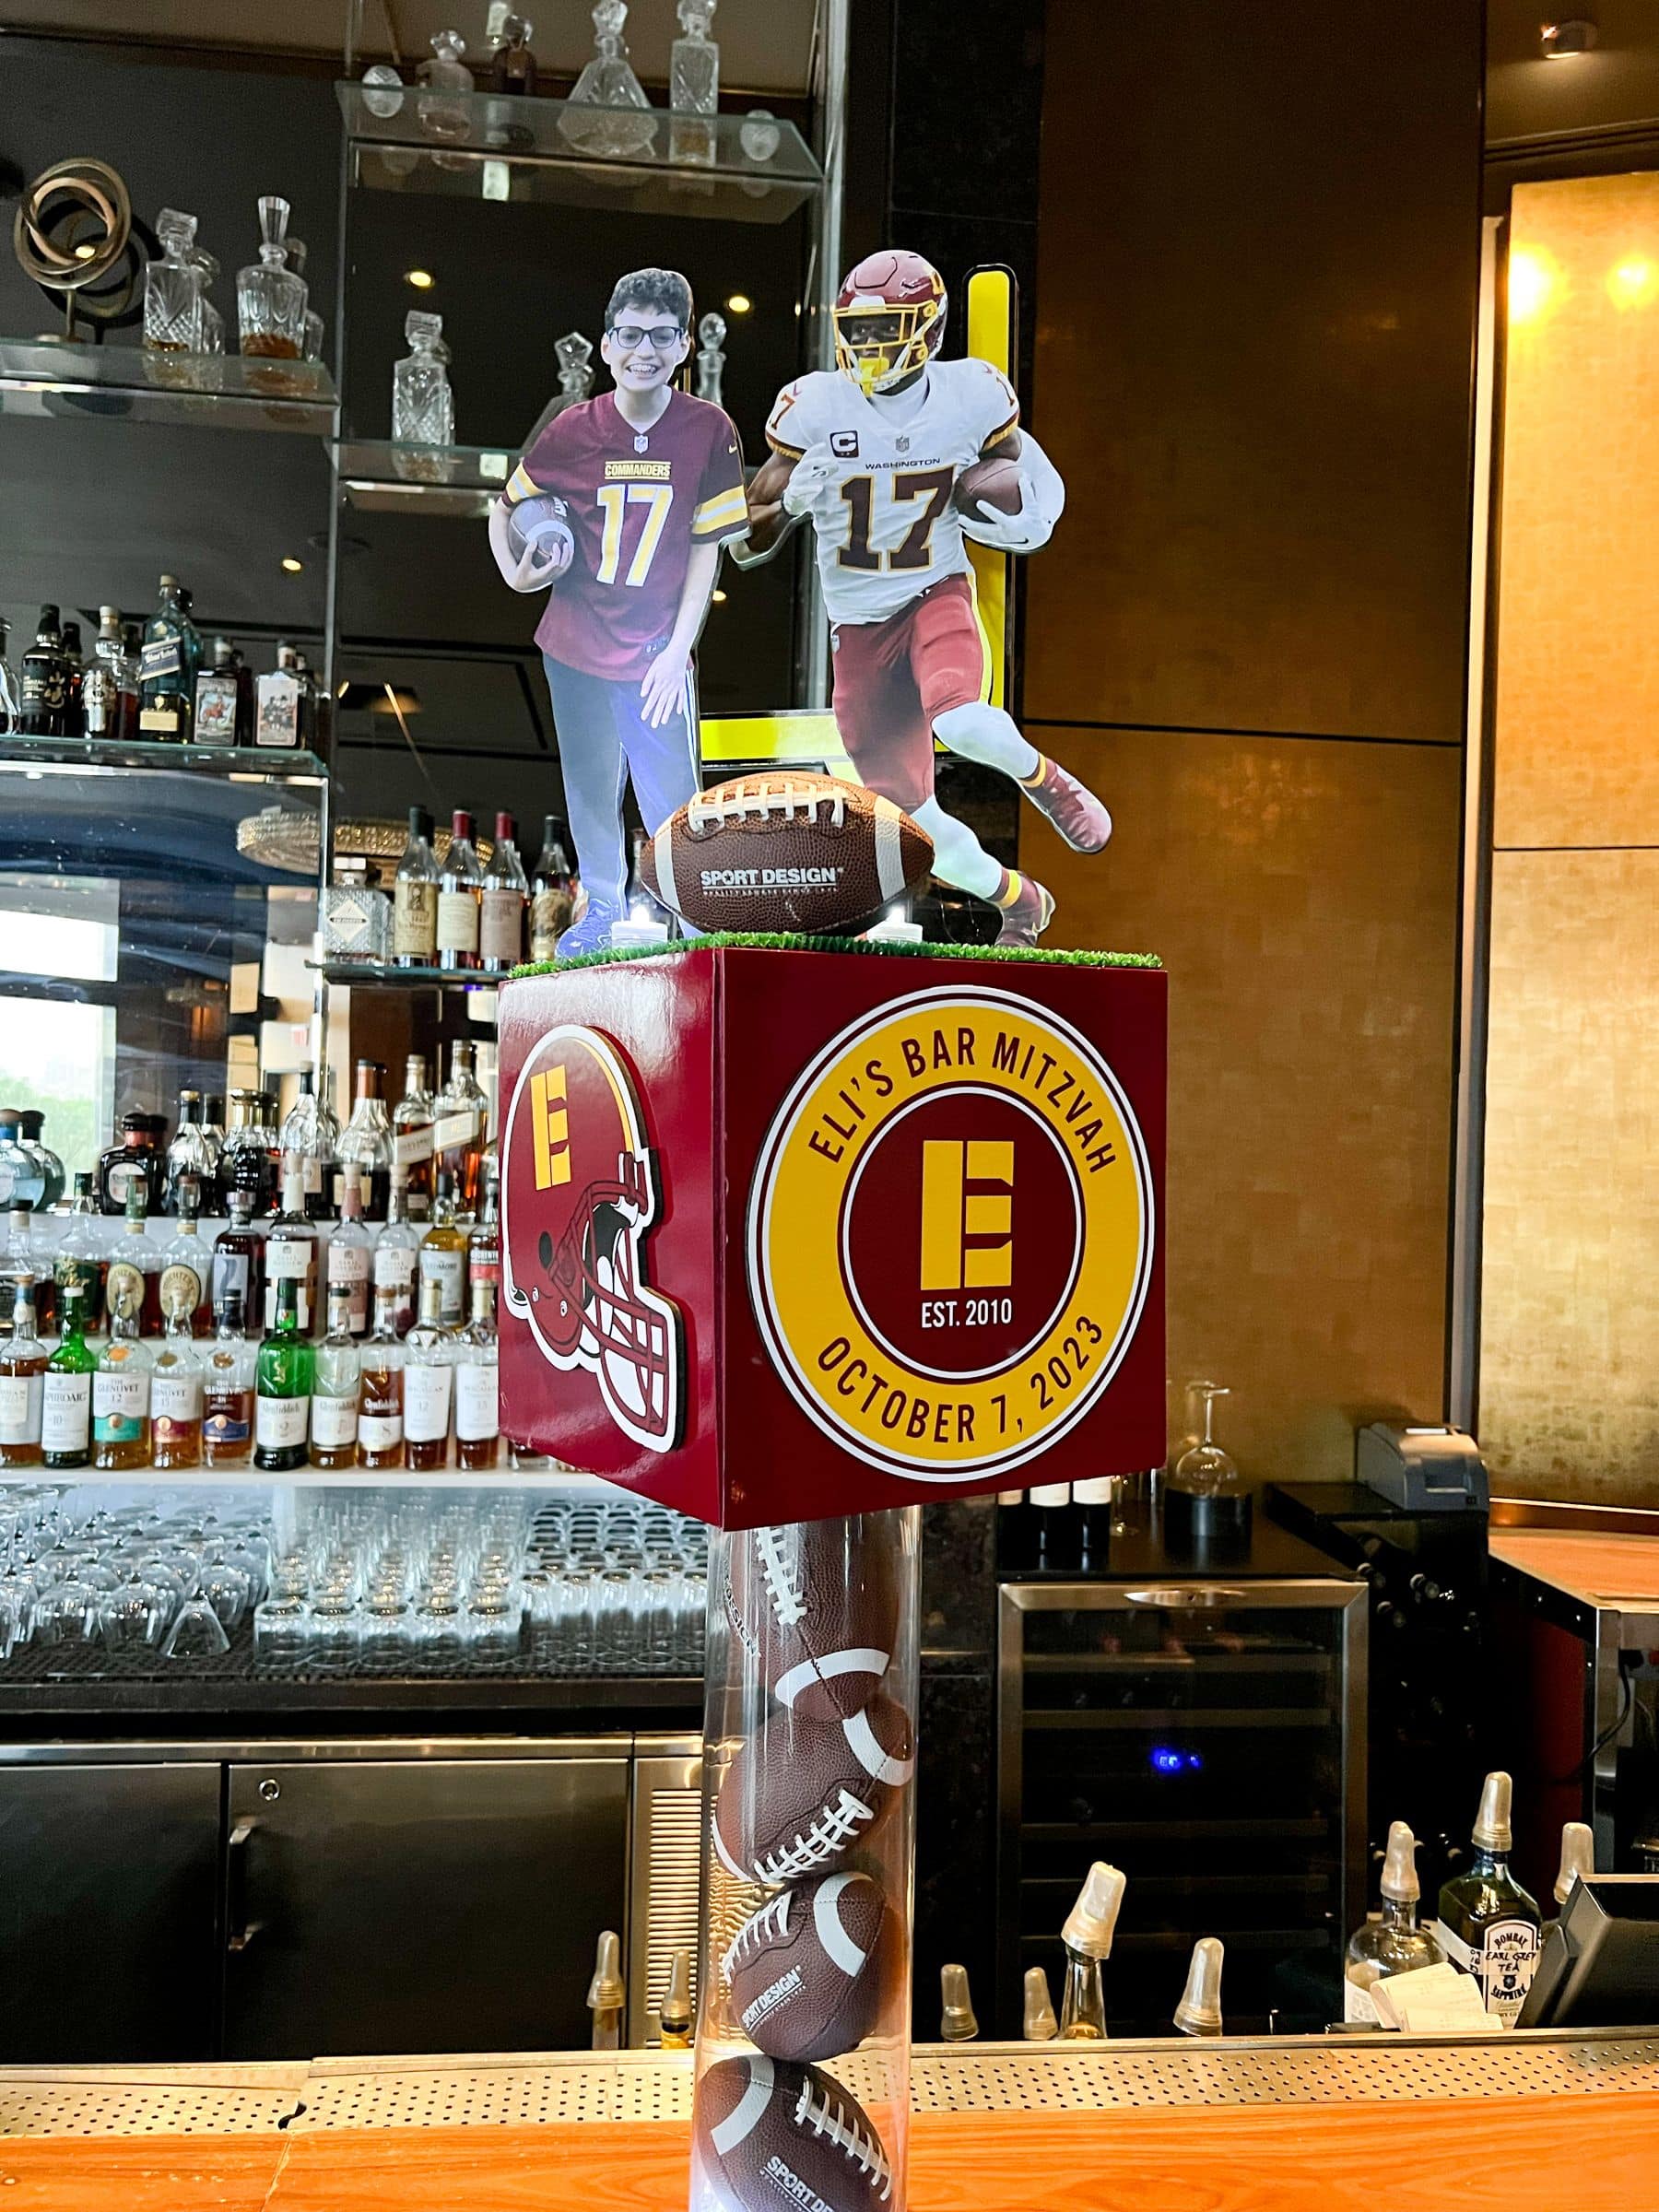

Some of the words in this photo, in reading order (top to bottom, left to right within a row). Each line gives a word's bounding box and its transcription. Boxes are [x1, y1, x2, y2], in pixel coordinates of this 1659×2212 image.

[605, 464, 671, 477] COMMANDERS
[865, 458, 941, 470] WASHINGTON
[596, 484, 674, 587] 17
[837, 464, 955, 571] 17
[700, 870, 759, 886] SPORT
[762, 867, 837, 885] DESIGN
[808, 1059, 894, 1163] ELI'S
[901, 1028, 975, 1078] BAR
[992, 1032, 1116, 1173] MITZVAH
[530, 1065, 571, 1191] E
[921, 1140, 1014, 1290] E
[922, 1301, 960, 1328] EST.
[966, 1299, 1012, 1325] 2010
[818, 1336, 975, 1442] OCTOBER
[991, 1395, 1024, 1433] 7,
[1030, 1315, 1102, 1409] 2023
[1485, 1951, 1510, 1961] EARL
[1512, 1951, 1537, 1962] GREY
[1494, 1932, 1529, 1950] BOMBAY
[1498, 1961, 1520, 1972] TEA
[758, 1969, 802, 2010] DESIGN
[767, 2156, 816, 2206] SPORT
